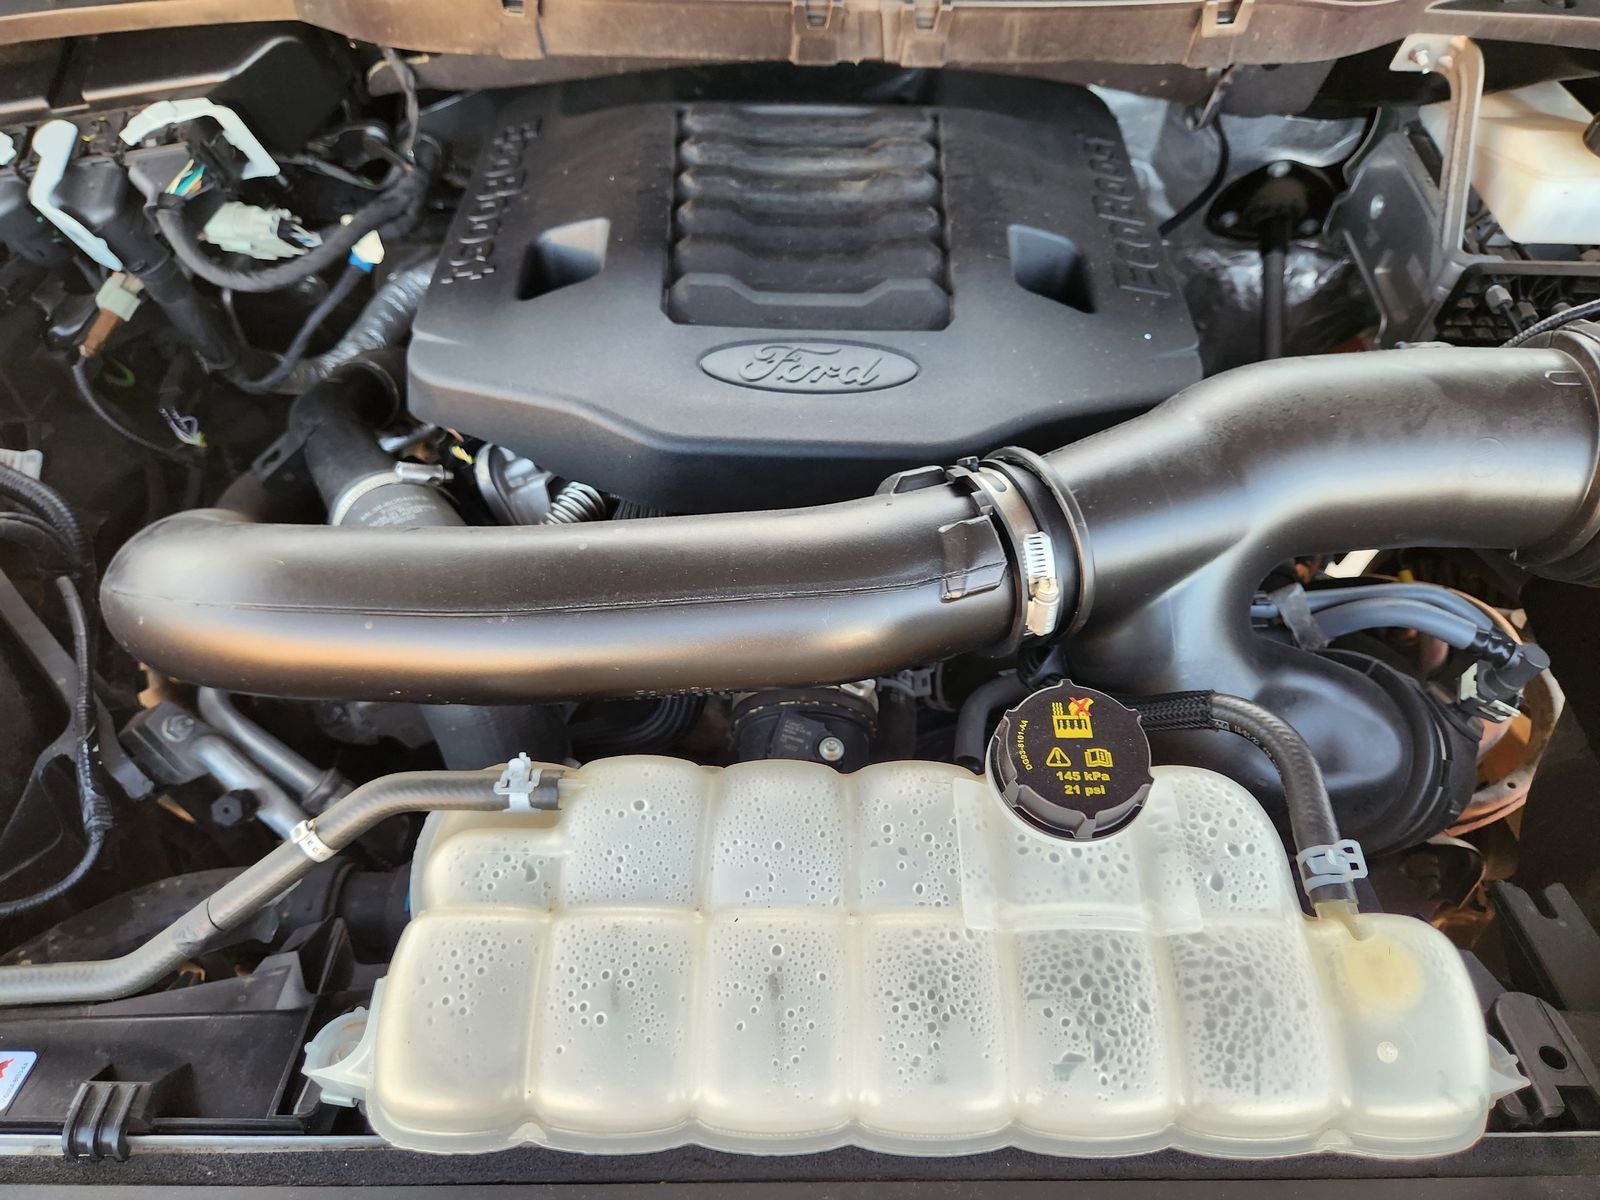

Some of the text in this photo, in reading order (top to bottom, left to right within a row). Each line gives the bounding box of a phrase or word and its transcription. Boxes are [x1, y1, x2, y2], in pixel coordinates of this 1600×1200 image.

[738, 344, 883, 386] Ford
[1056, 771, 1110, 781] 145 kPa
[1064, 784, 1106, 797] 21 psi
